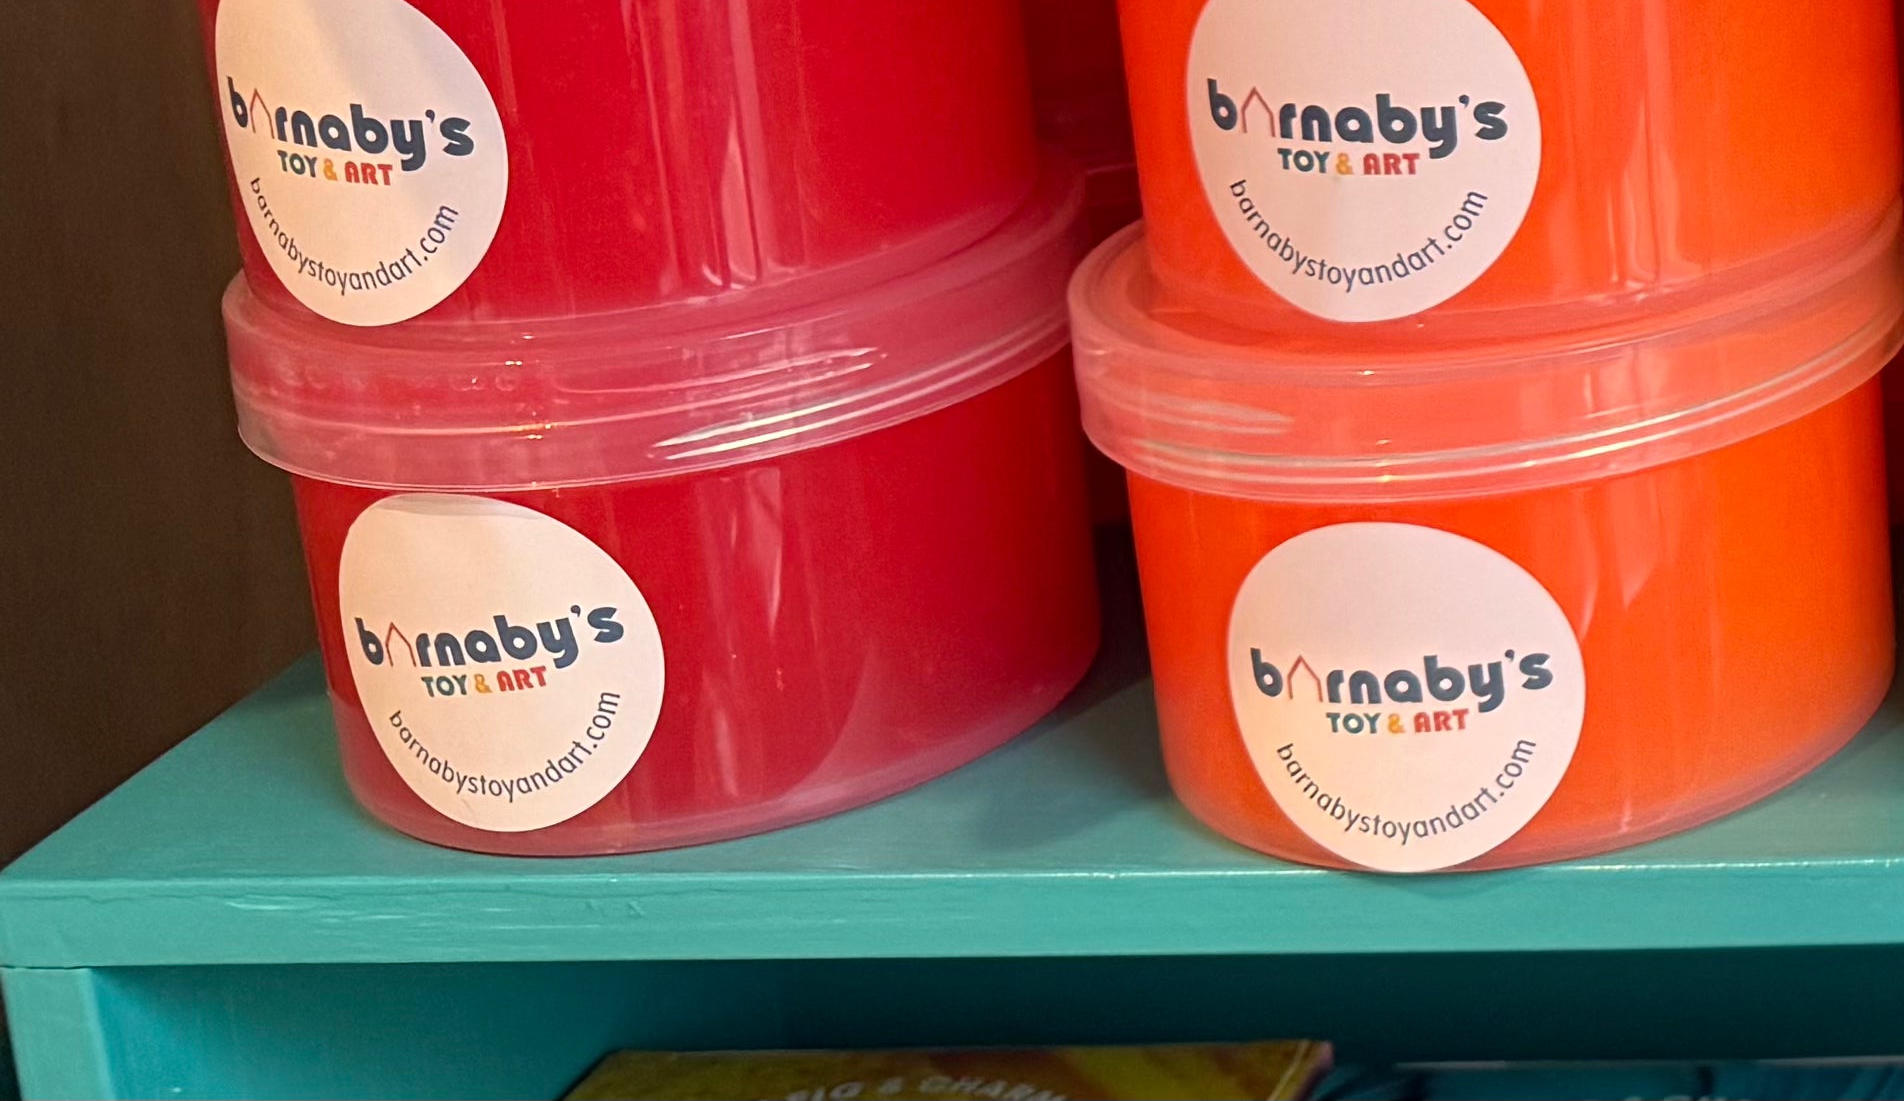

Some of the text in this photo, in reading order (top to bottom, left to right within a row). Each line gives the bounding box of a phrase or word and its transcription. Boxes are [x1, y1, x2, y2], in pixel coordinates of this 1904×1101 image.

[276, 150, 395, 187] TOY & ART
[1276, 145, 1421, 177] TOY & ART
[247, 175, 460, 299] barnabystoyandart.com
[1228, 178, 1491, 295] barnabystoyandart.com
[420, 665, 549, 697] TOY & ART
[387, 690, 622, 804] barnabystoyandart.com
[1326, 708, 1471, 735] TOY & ART
[1276, 738, 1538, 846] barnabystoyandart.com
